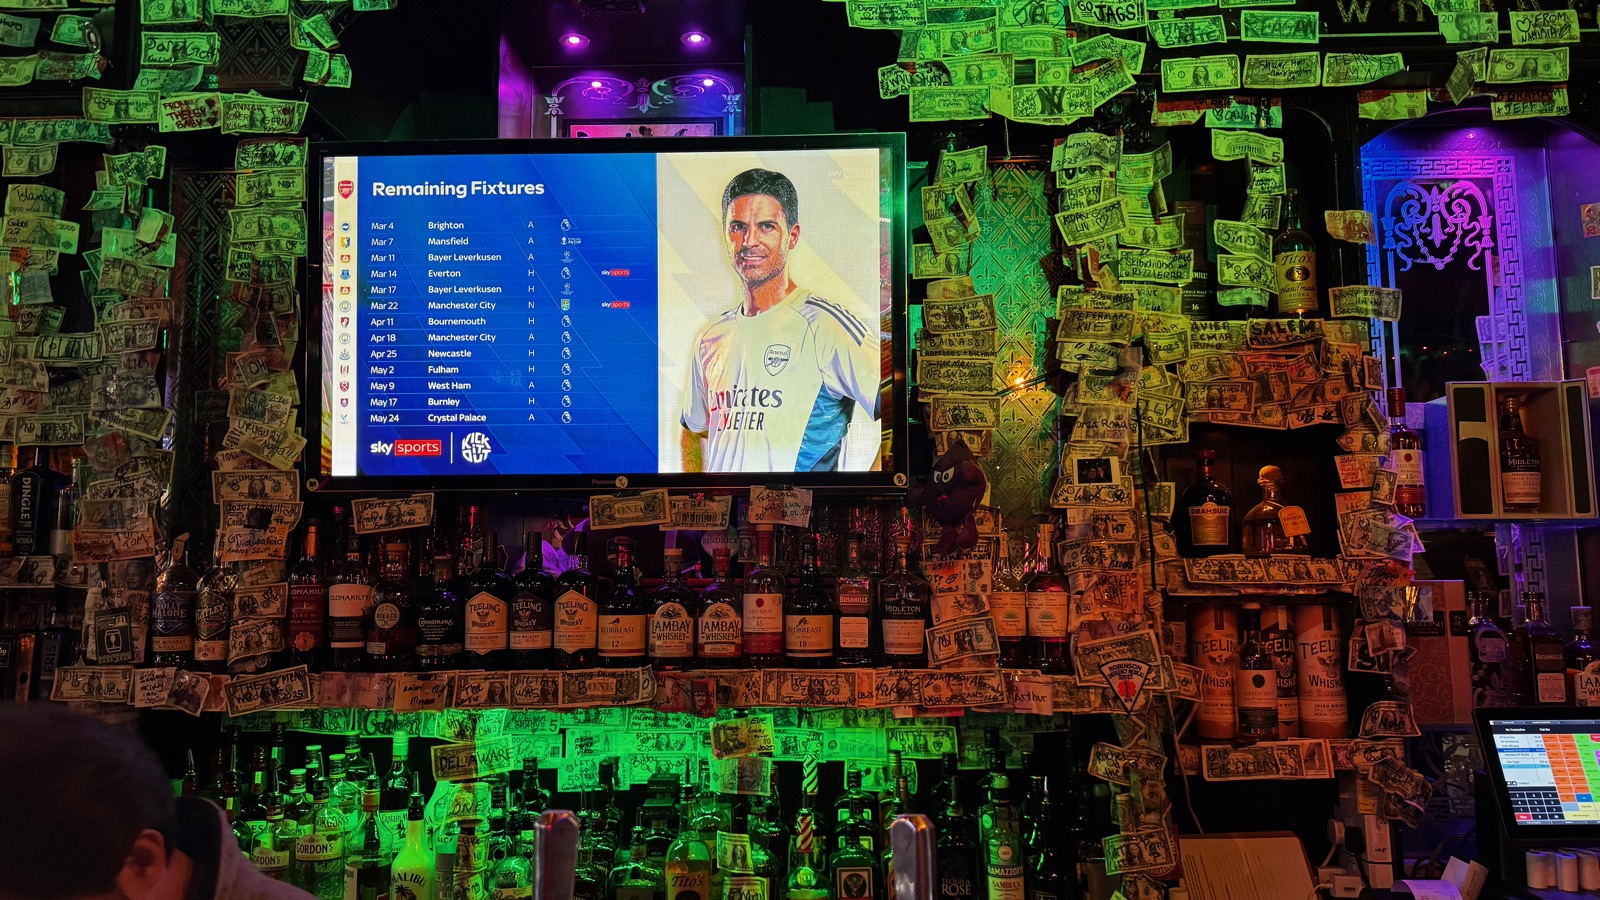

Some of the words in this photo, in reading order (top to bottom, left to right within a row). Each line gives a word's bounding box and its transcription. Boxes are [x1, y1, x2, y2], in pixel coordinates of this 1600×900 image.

[1442, 14, 1454, 23] 20
[1535, 12, 1568, 22] FROM
[1505, 102, 1537, 115] JEFF
[1272, 152, 1280, 163] 5
[372, 181, 468, 199] Remaining
[471, 180, 545, 195] Fixtures
[371, 222, 387, 231] Mar
[388, 222, 394, 231] 4
[428, 221, 464, 231] Brighton
[371, 237, 387, 246] Mar
[388, 237, 394, 246] 7
[428, 237, 468, 246] Mansfield
[371, 254, 387, 262] Mar
[388, 254, 395, 262] 11
[428, 253, 452, 263] Bayer
[454, 253, 502, 262] Leverkusen
[1281, 253, 1312, 266] Tito's
[371, 270, 387, 278] Mar
[388, 270, 397, 278] 14
[428, 269, 461, 278] Everton
[371, 286, 387, 294] Mar
[388, 286, 396, 294] 17
[428, 285, 452, 295] Bayer
[454, 285, 502, 294] Leverkusen
[1279, 284, 1316, 295] Handmade
[371, 302, 387, 310] Mar
[388, 302, 398, 310] 22
[428, 301, 477, 310] Manchester
[478, 301, 496, 311] City
[371, 318, 386, 327] Apr
[428, 317, 486, 326] Bournemouth
[371, 334, 386, 343] Apr
[428, 333, 477, 342] Manchester
[478, 333, 496, 343] City
[371, 350, 386, 359] Apr
[428, 349, 472, 358] Newcastle
[371, 366, 386, 376] May
[388, 366, 394, 374] 2
[428, 366, 459, 374] Fulham
[371, 382, 386, 392] May
[388, 382, 394, 390] 9
[428, 382, 448, 390] West
[450, 382, 471, 390] Ham
[371, 398, 386, 408] May
[388, 398, 397, 406] 17
[428, 398, 460, 408] Burnley
[371, 414, 386, 424] May
[388, 414, 399, 422] 24
[428, 414, 455, 424] Crystal
[457, 414, 486, 422] Palace
[462, 432, 490, 449] KICK
[370, 440, 394, 456] sky
[397, 442, 440, 454] sports
[462, 450, 492, 464] OUT
[20, 476, 32, 520] DINGLE
[1190, 507, 1228, 516] DRAMBUIE
[703, 536, 739, 546] HENDRICK
[289, 588, 328, 596] LONAKILTY
[840, 596, 868, 604] BUSHMILLS
[468, 602, 500, 614] TEELING
[512, 602, 542, 612] TEELING
[558, 601, 588, 612] TEELING
[885, 605, 921, 613] MIDLETON
[471, 620, 496, 628] WHISKEY
[514, 618, 537, 627] WHISKEY
[560, 618, 584, 626] WHISKEY
[652, 620, 691, 634] LAMBAY
[700, 620, 740, 634] LAMBAY
[656, 632, 687, 640] WHISKEY
[706, 632, 735, 640] WHISKEY
[610, 640, 620, 648] 12
[798, 640, 808, 648] 18
[1193, 640, 1238, 657] TEELIN
[1299, 640, 1342, 659] TEELIN
[1108, 664, 1142, 673] ROBINSON
[1202, 673, 1234, 688] WHISK
[1276, 673, 1297, 688] HISKE
[1308, 674, 1341, 688] WHISK
[439, 746, 514, 771] DELAWARE
[382, 812, 403, 823] Captain
[296, 842, 334, 855] GORDON'S
[391, 872, 426, 888] MALIBU
[672, 875, 704, 887] Tito's
[992, 880, 1021, 889] SAMBUCA
[942, 884, 972, 896] ROSE
